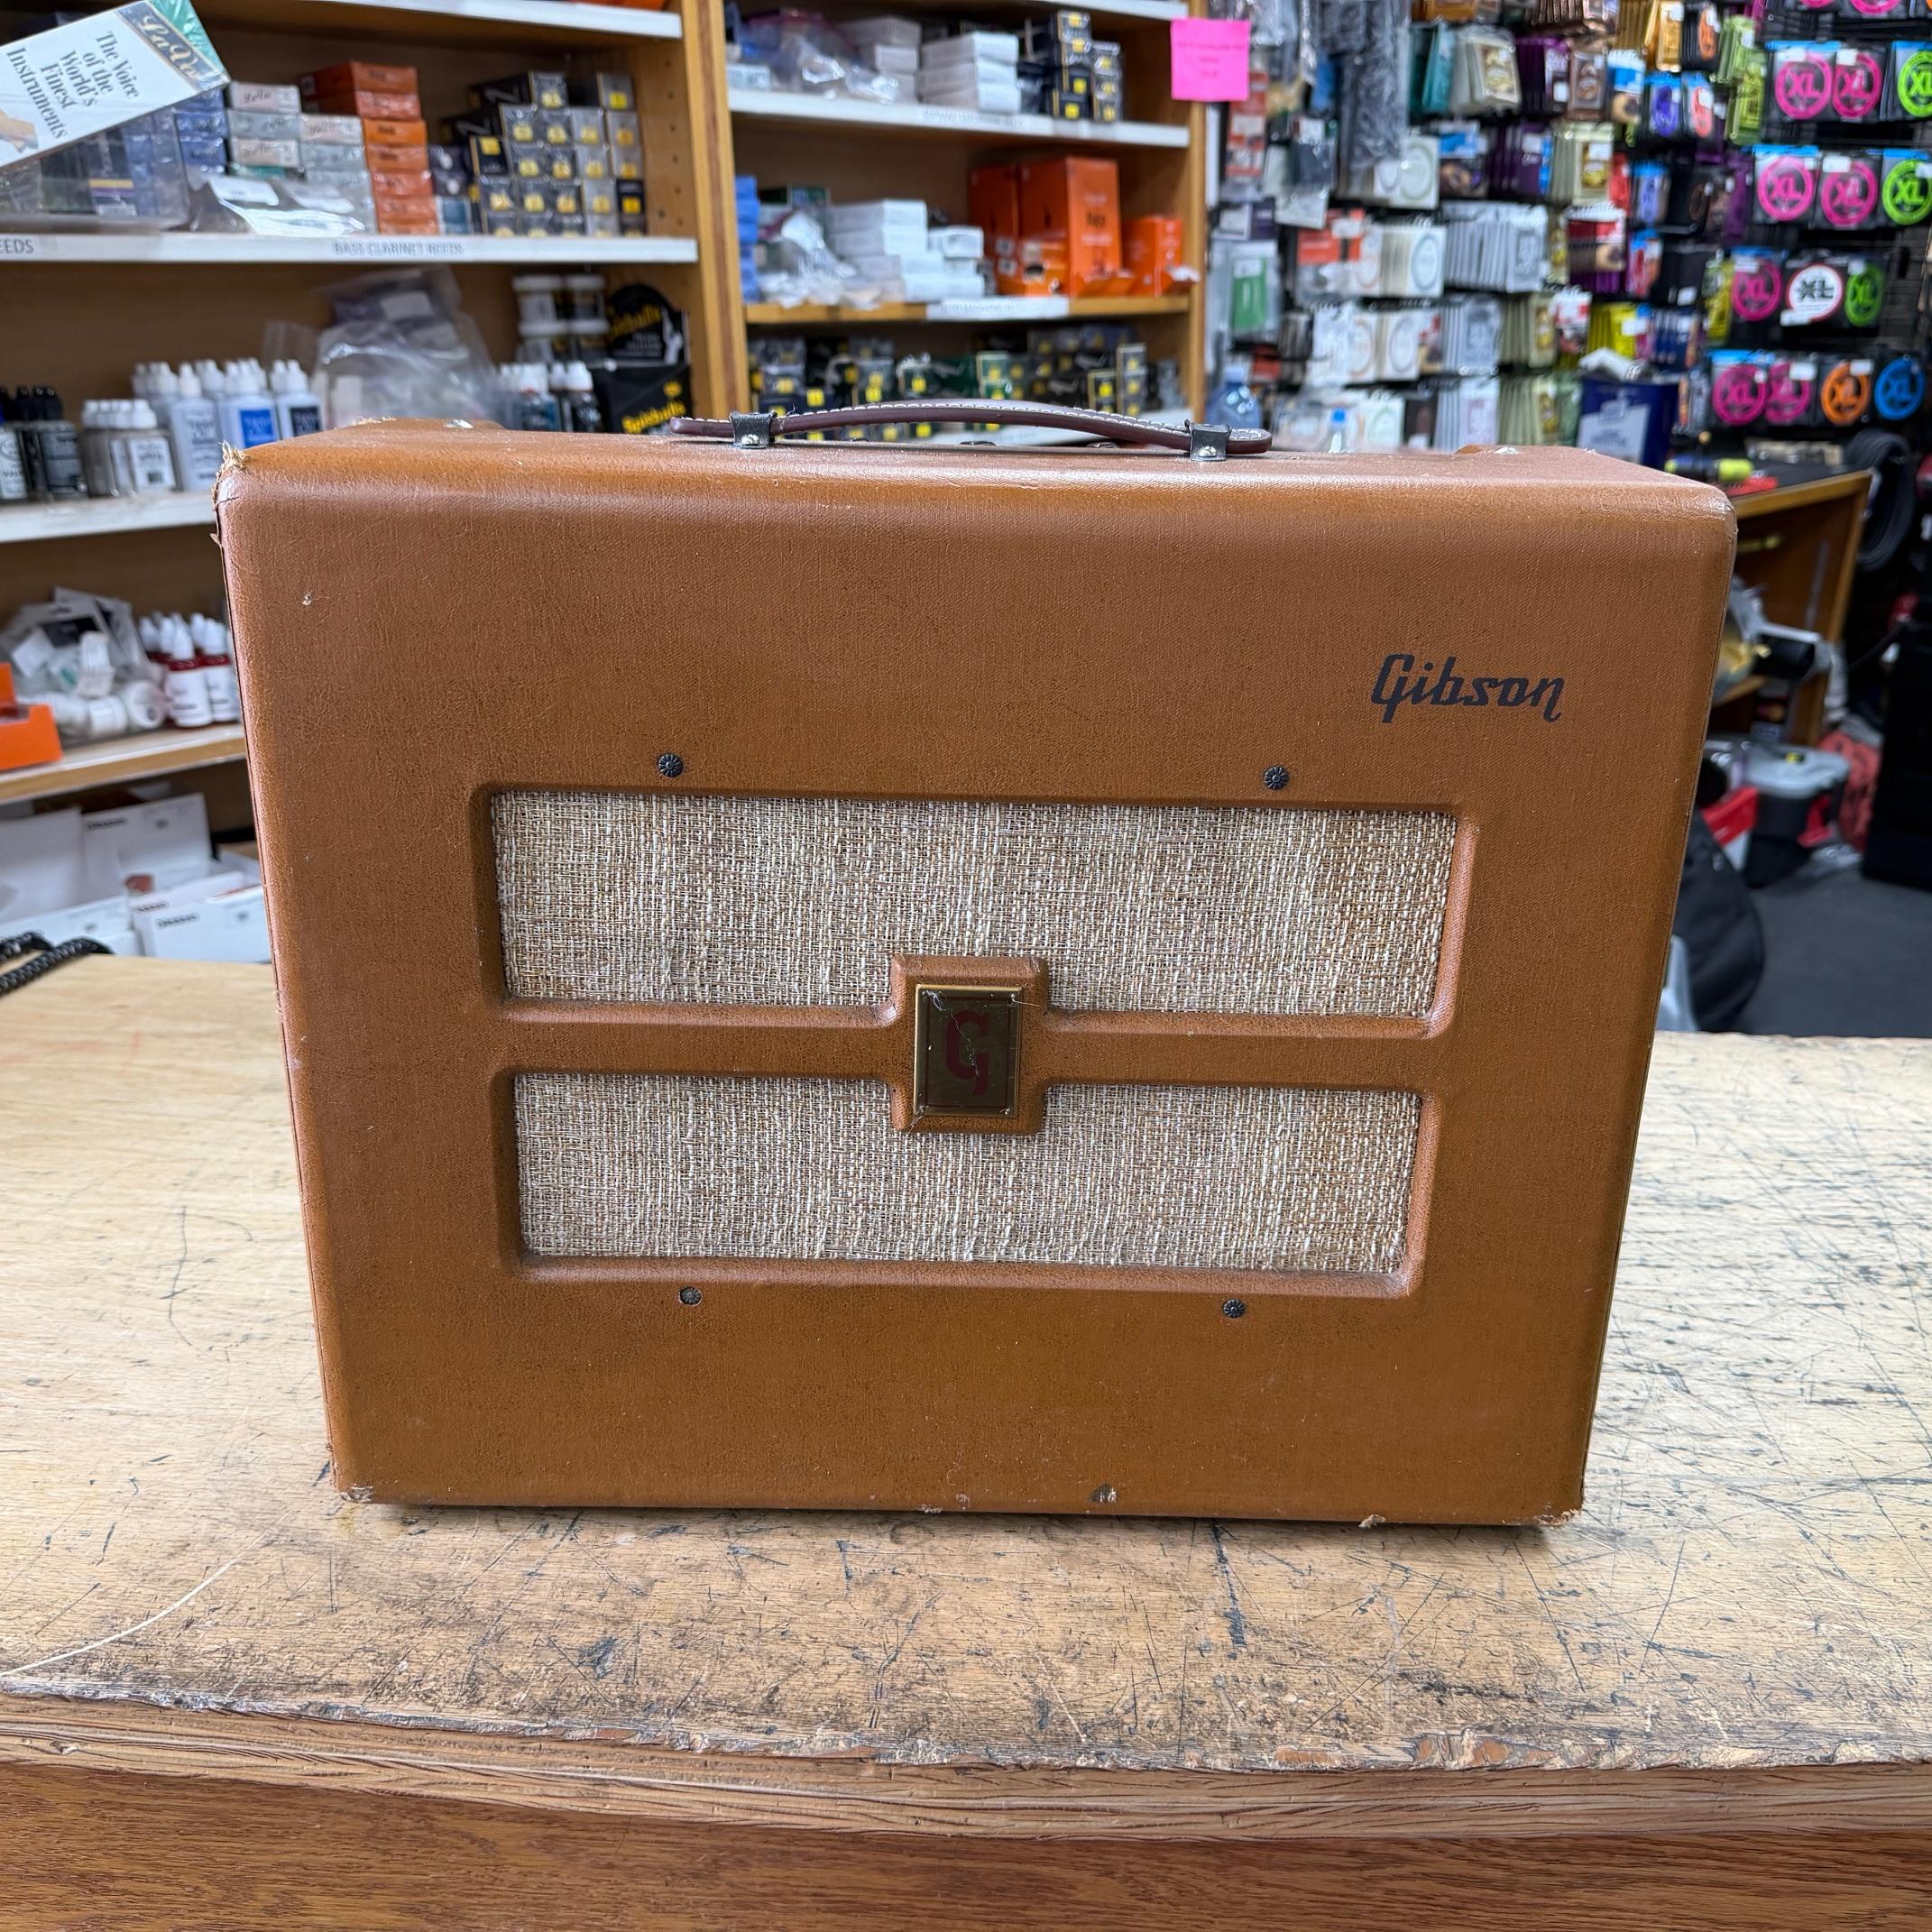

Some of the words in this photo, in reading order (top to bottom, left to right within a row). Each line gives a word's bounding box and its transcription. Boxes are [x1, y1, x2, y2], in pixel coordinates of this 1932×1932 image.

[82, 51, 106, 69] of
[96, 31, 119, 61] The
[113, 60, 140, 99] Voice
[6, 47, 69, 139] Instruments
[40, 62, 79, 109] Finest
[60, 51, 98, 107] World's
[91, 68, 115, 94] the
[1786, 71, 1821, 98] XL
[1769, 175, 1803, 200] XL
[1892, 179, 1925, 205] XL
[1797, 279, 1835, 301] XL
[1370, 652, 1566, 724] Gibson
[946, 1009, 990, 1097] G
